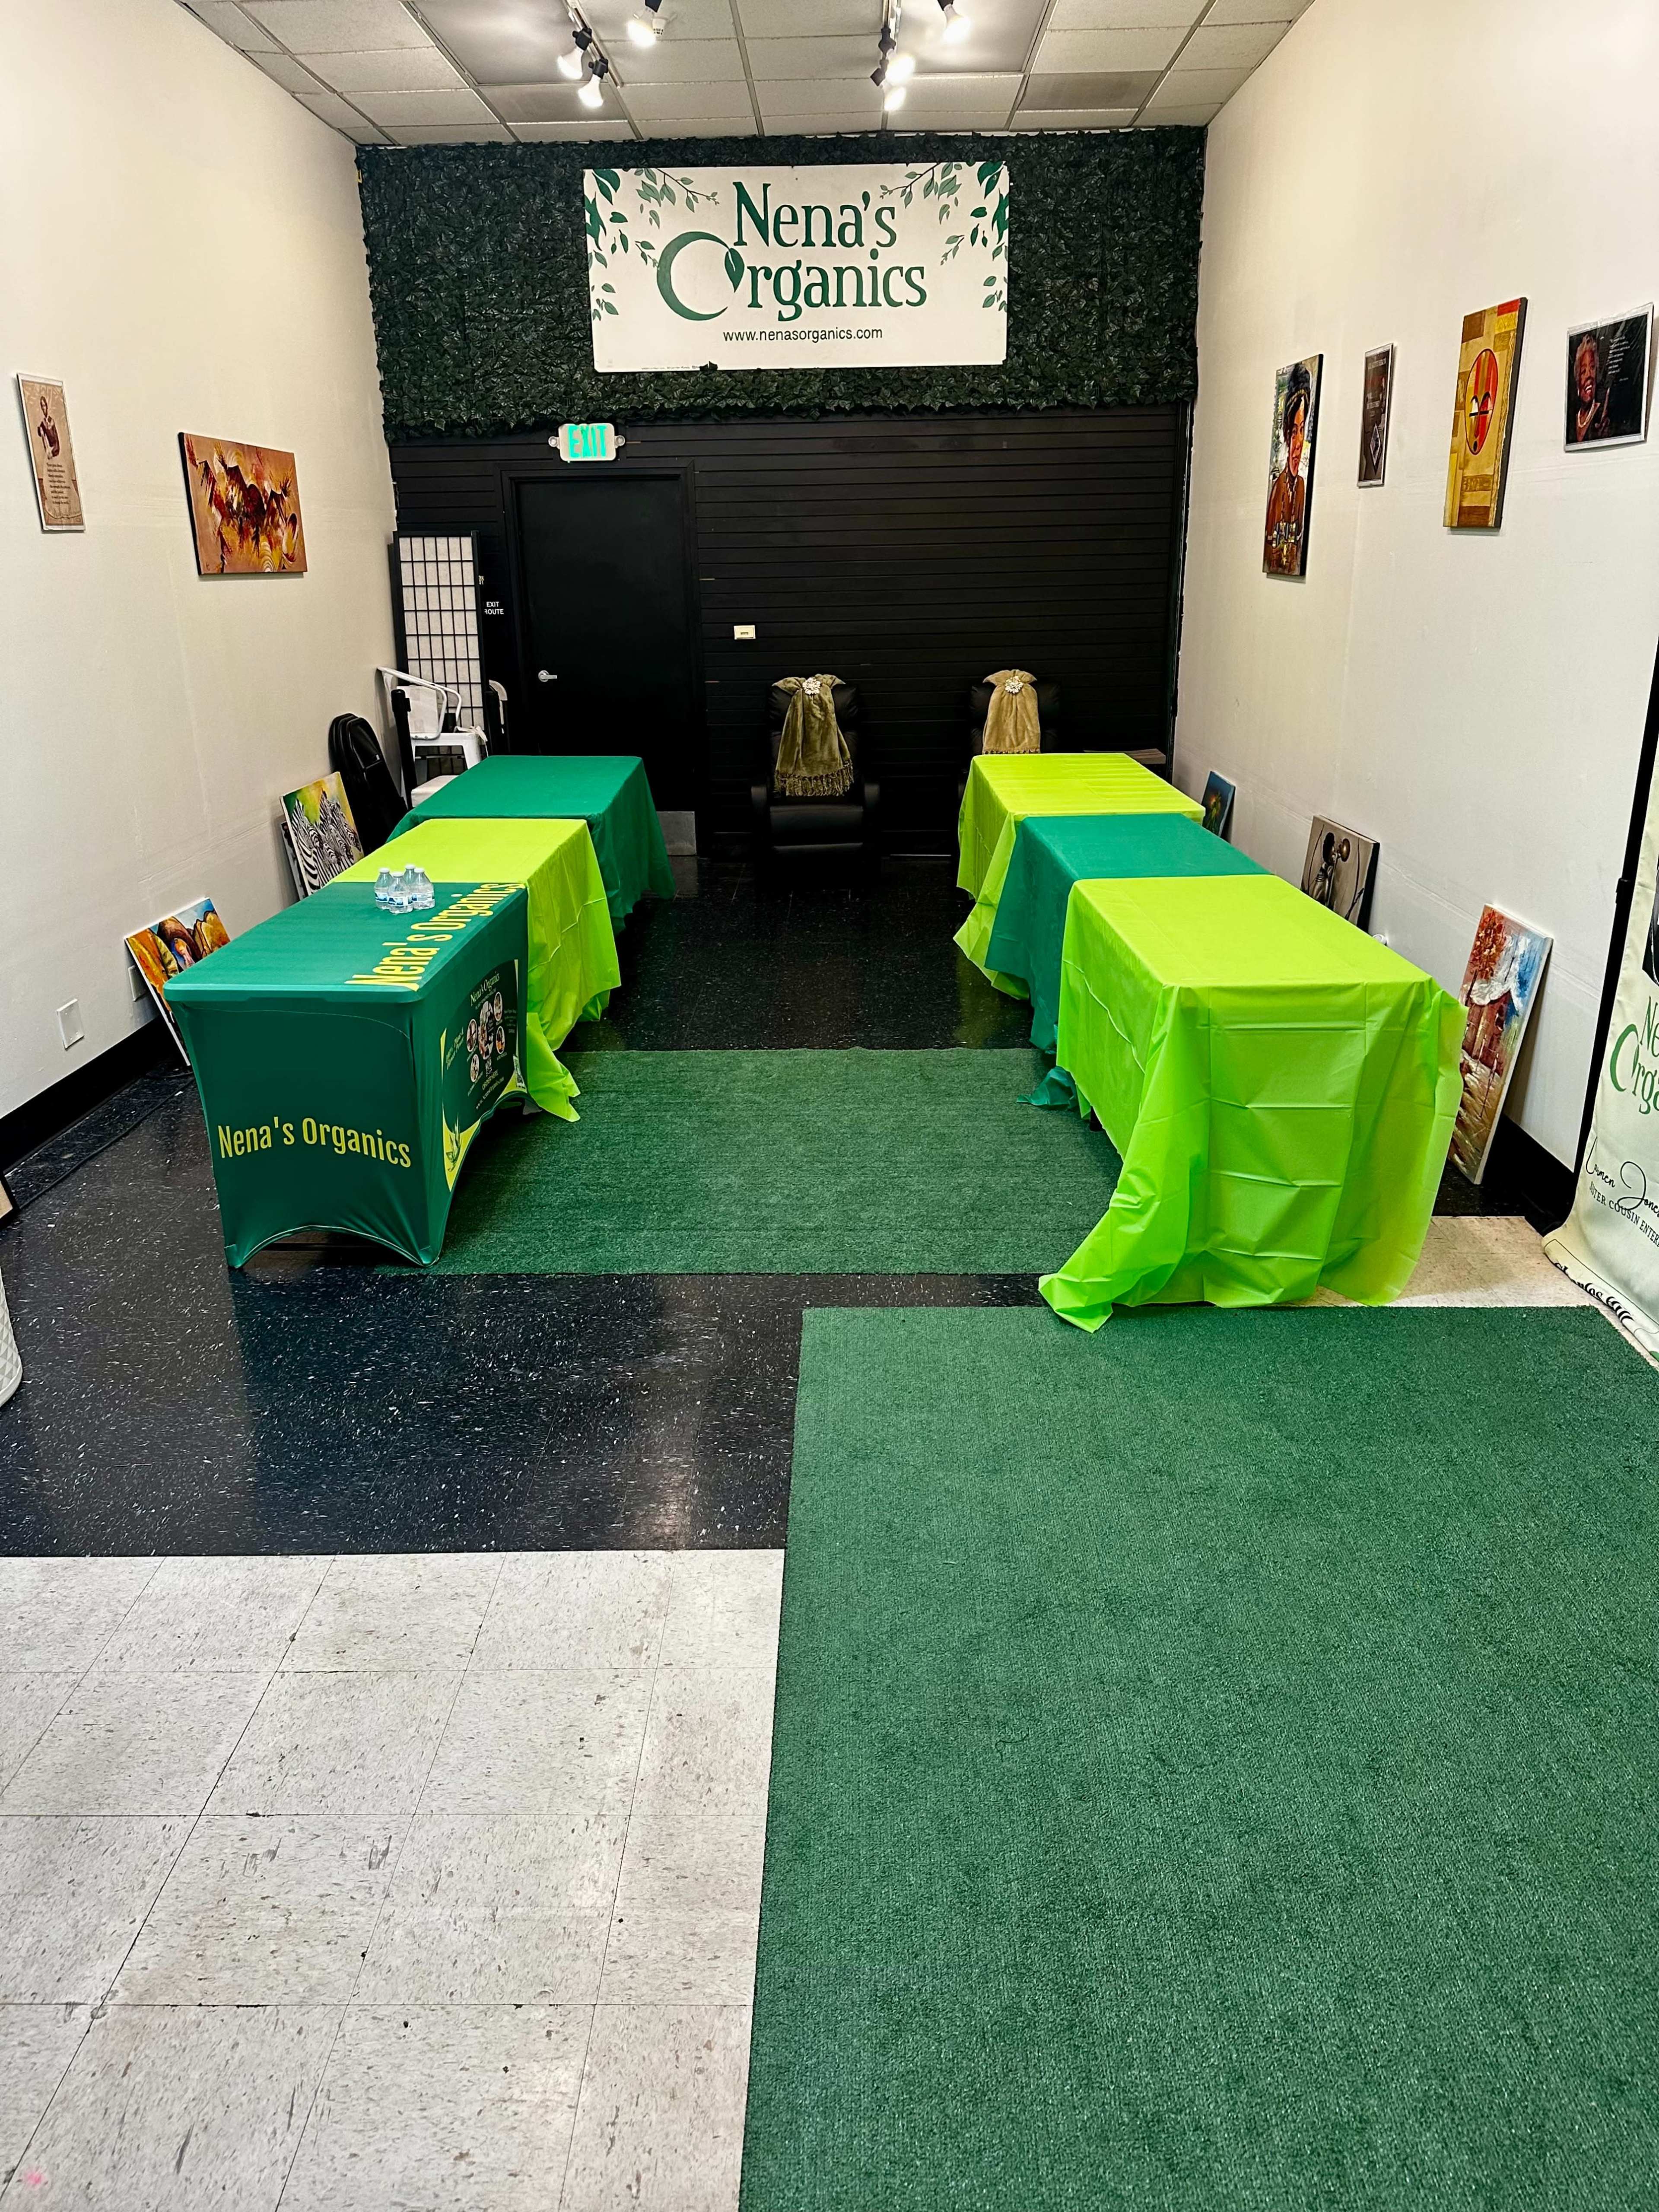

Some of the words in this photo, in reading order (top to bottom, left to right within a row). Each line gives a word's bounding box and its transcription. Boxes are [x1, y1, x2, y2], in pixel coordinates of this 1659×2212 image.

[734, 181, 897, 248] Nena's
[656, 231, 928, 321] Organics
[723, 327, 883, 343] www.nenasorganics.com
[568, 425, 607, 458] EXIT
[344, 933, 454, 992] Nena's
[410, 882, 526, 931] Organics
[470, 984, 484, 1007] Nena's
[218, 1116, 295, 1159] Nena's
[302, 1117, 411, 1168] Organics
[1609, 1200, 1640, 1226] COUSIN
[1640, 1220, 1659, 1248] ENTER
